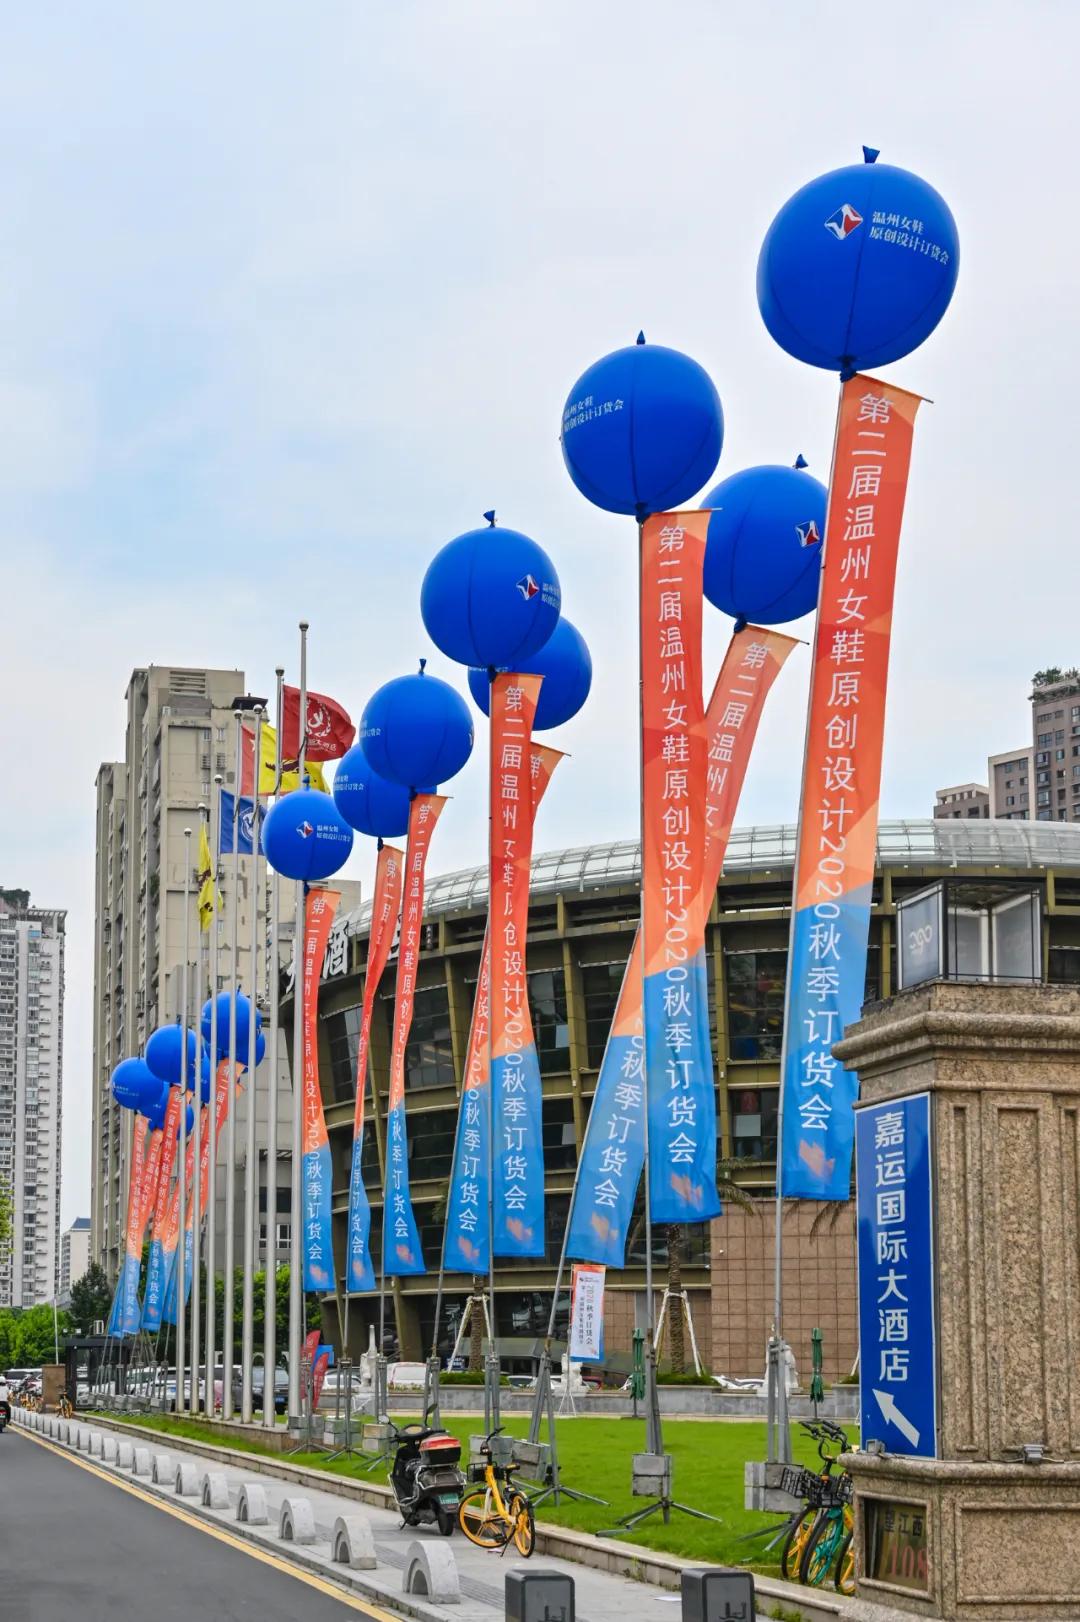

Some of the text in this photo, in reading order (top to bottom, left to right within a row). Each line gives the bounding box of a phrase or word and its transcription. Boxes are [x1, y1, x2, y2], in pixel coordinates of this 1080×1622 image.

[869, 226, 950, 266] 原创设计订货会
[872, 210, 924, 234] 温州女鞋
[657, 525, 698, 1164] 第二届温州女鞋原创设计2020秋季订货会
[798, 392, 894, 1131] 第二届温州女鞋原创设计2020秋季订货会
[874, 1110, 909, 1382] 嘉运国际大酒店
